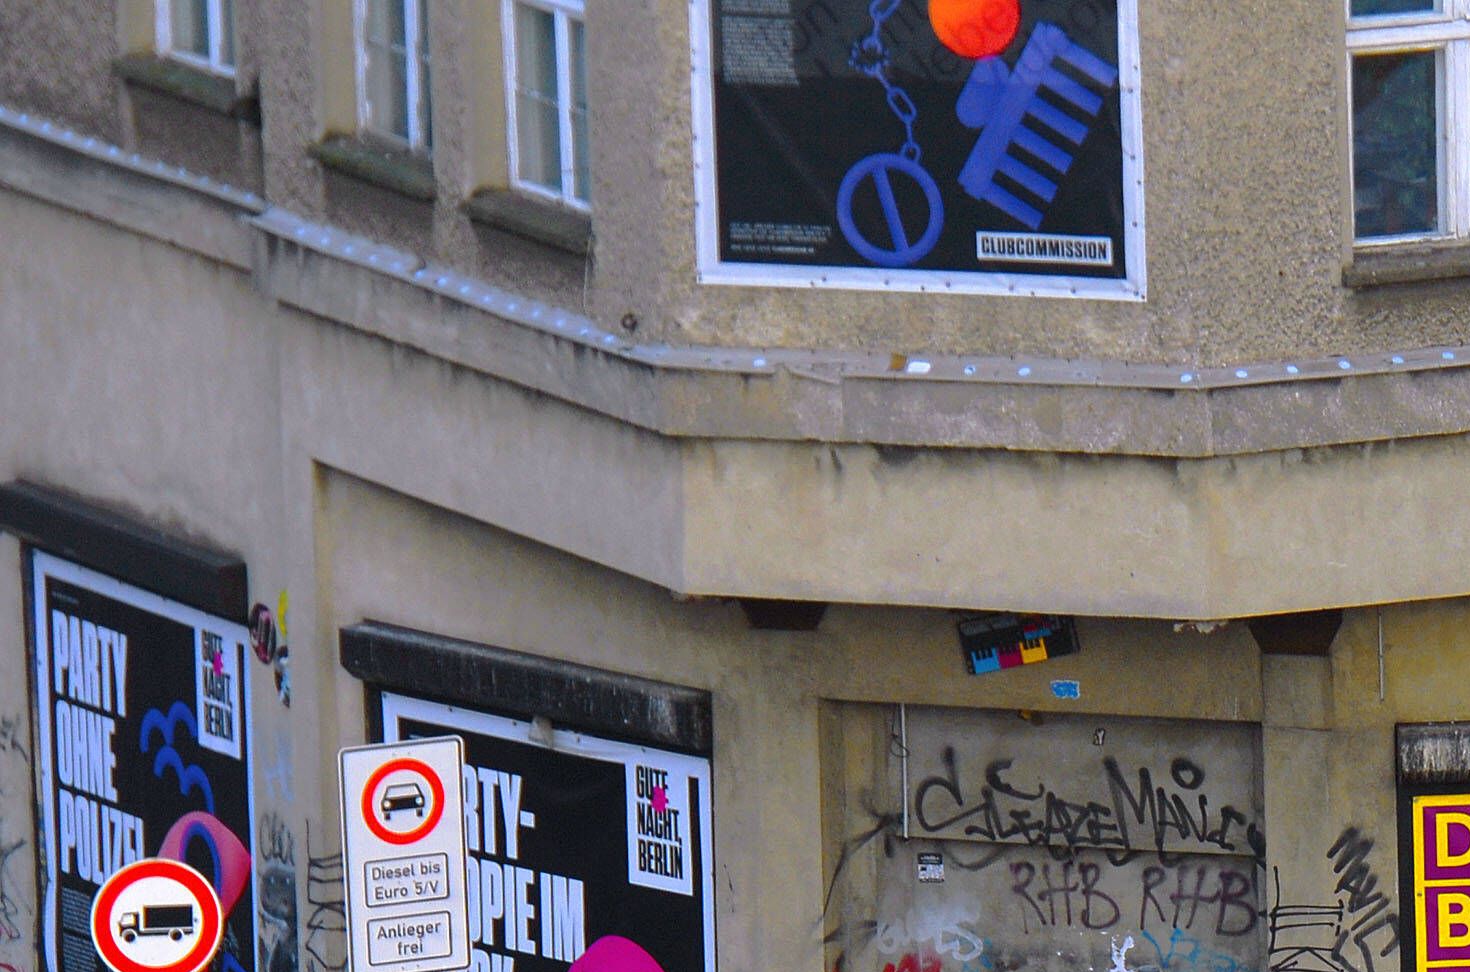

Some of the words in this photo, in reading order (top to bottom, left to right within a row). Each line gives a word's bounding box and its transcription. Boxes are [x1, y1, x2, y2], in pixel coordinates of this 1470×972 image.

[981, 235, 1108, 260] CLUBCOMMISSION
[52, 608, 128, 718] PARTY
[55, 700, 118, 804] OHNE
[462, 763, 536, 860] RTY-
[371, 864, 415, 881] Diesel
[419, 860, 441, 875] bis
[637, 838, 684, 880] BERLIN
[374, 885, 409, 900] Euro
[415, 880, 439, 895] 5/V
[376, 920, 442, 940] Anlieger
[540, 871, 586, 963] IM
[397, 940, 424, 955] frei
